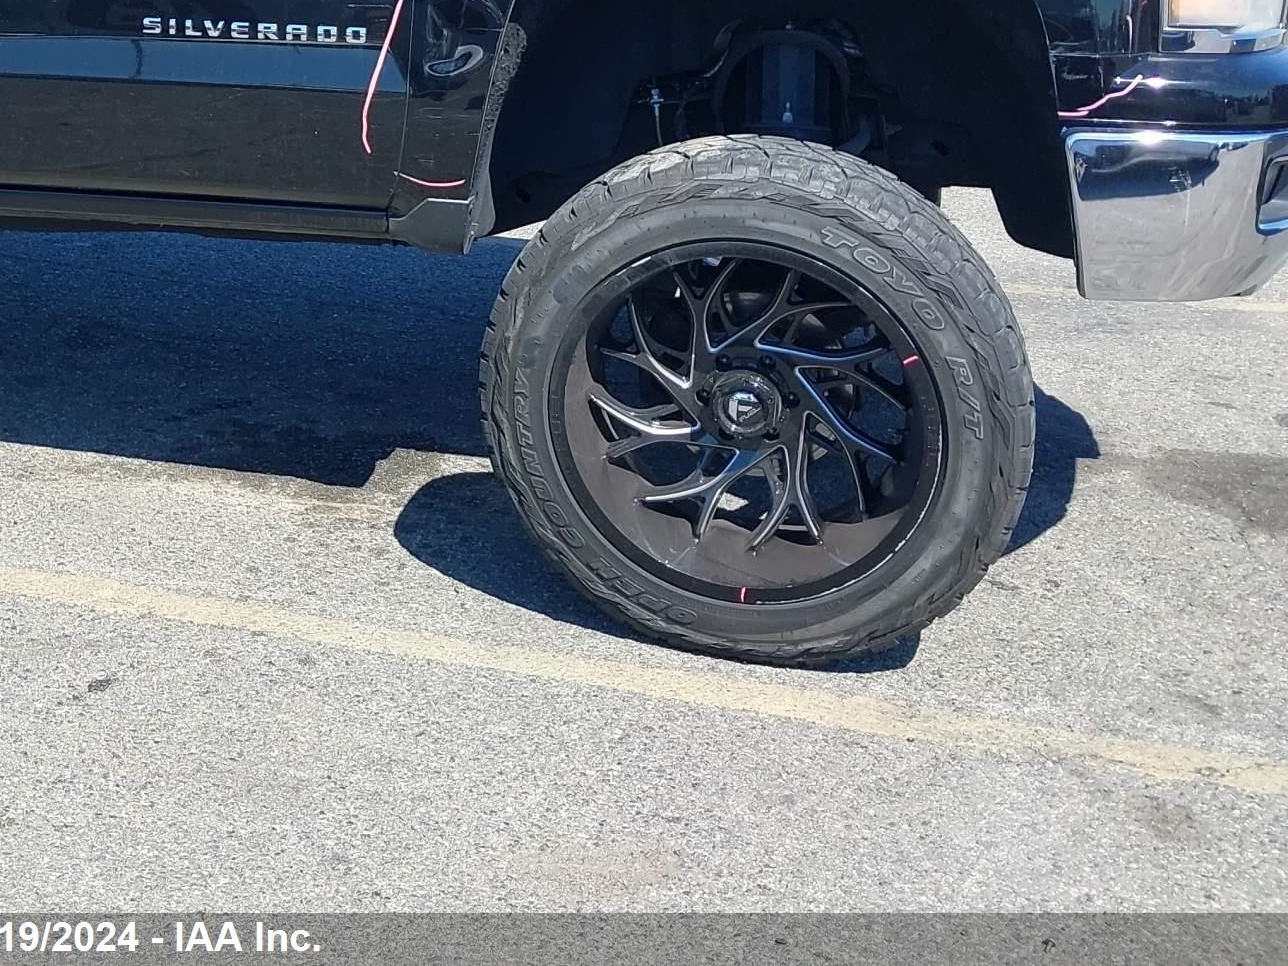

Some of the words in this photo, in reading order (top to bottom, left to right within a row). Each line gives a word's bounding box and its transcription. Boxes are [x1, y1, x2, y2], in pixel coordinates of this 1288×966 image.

[142, 17, 367, 44] SILVERADO
[821, 225, 945, 331] TOYO
[943, 355, 985, 441] R/T
[512, 366, 585, 549] COUNTRY
[585, 555, 697, 625] OPEN
